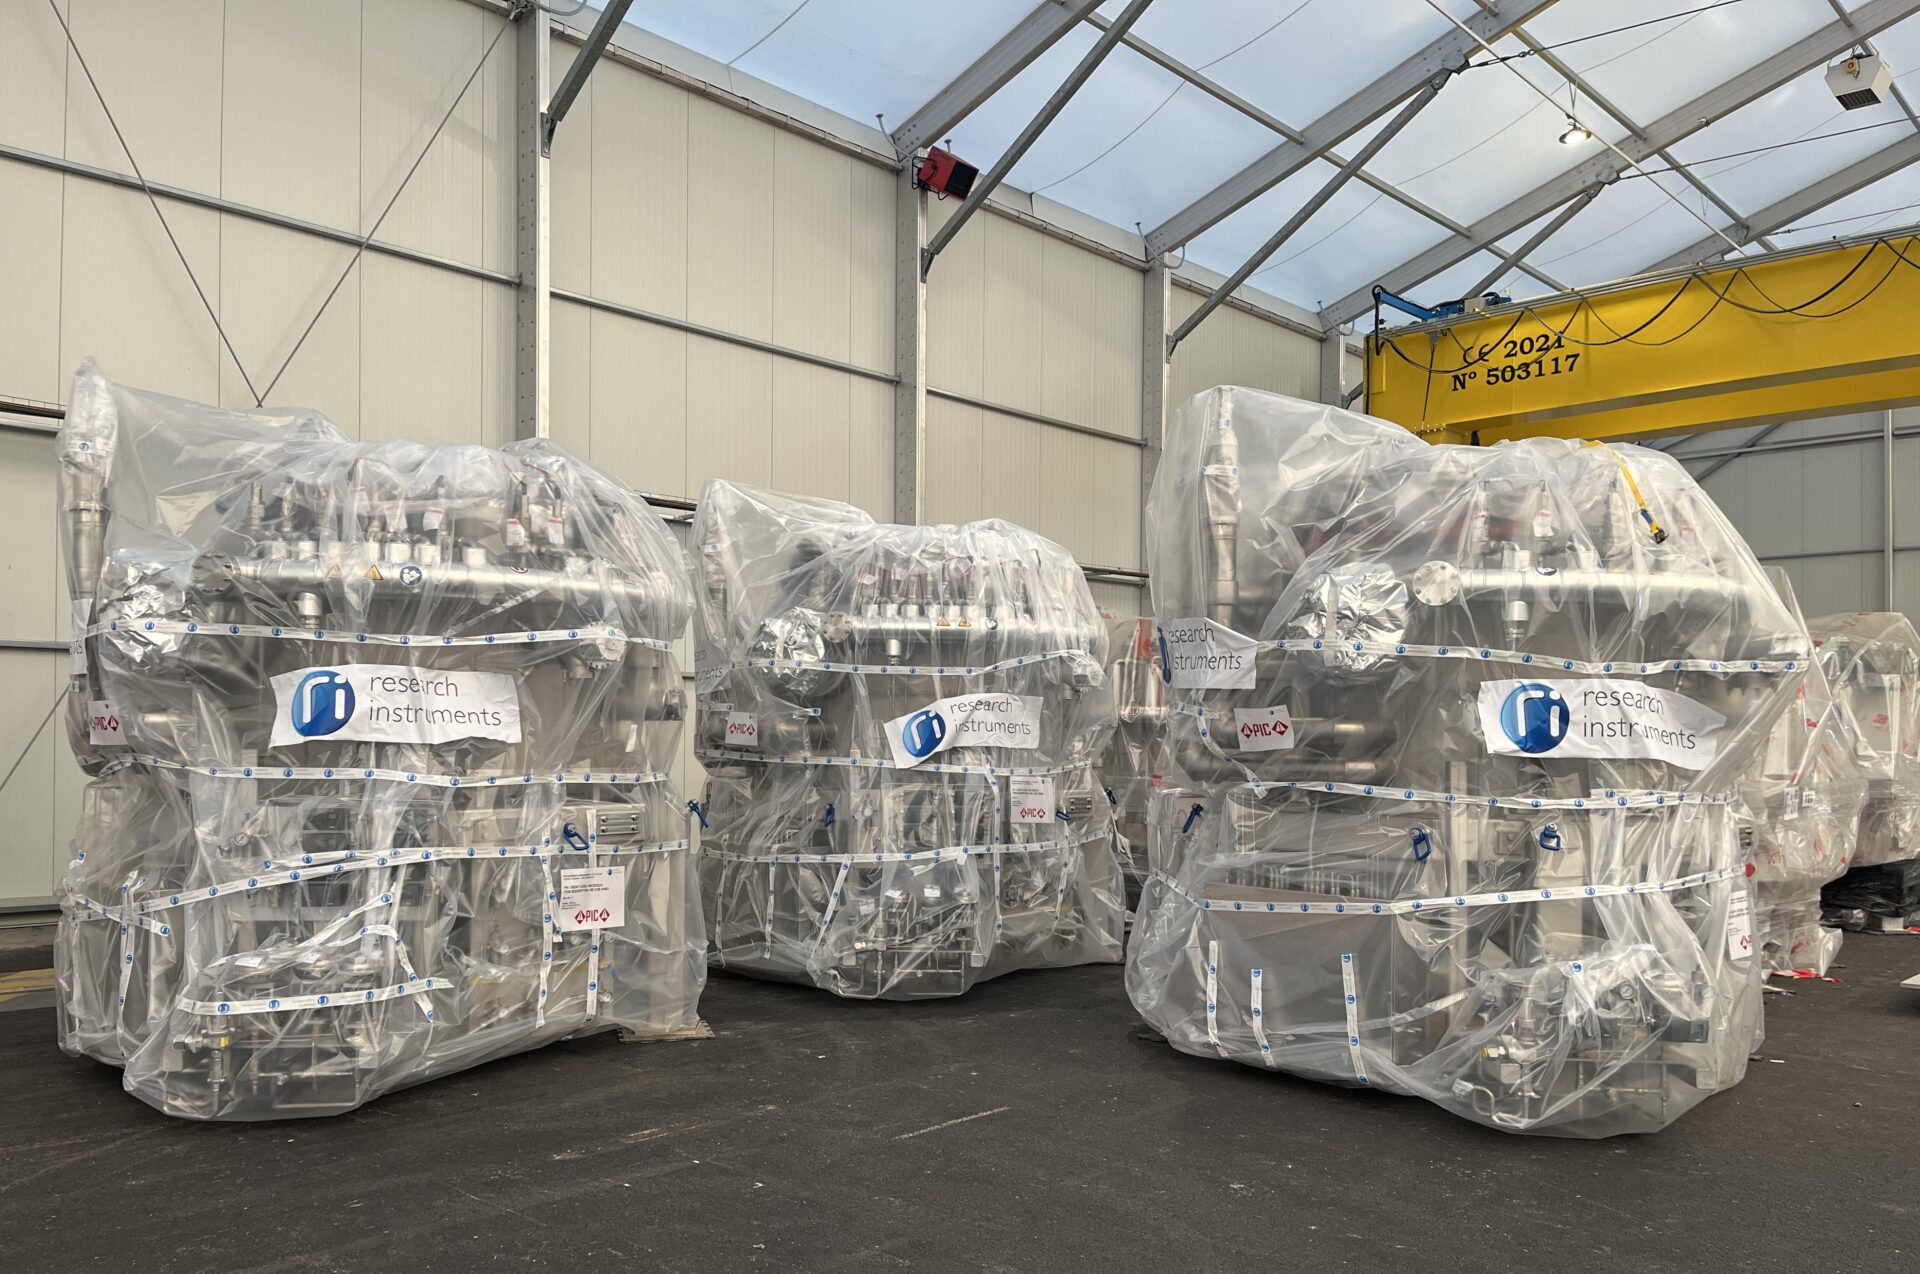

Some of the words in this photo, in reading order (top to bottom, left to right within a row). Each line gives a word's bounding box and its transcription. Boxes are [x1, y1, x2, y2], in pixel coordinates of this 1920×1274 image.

[1503, 331, 1566, 359] 2021
[1486, 353, 1580, 386] 503117
[1168, 622, 1215, 644] esearch
[950, 697, 1013, 714] research
[1583, 689, 1665, 715] research
[736, 723, 747, 734] PIC
[954, 719, 1031, 736] instruments
[1252, 723, 1272, 737] PIC
[1583, 715, 1697, 750] instruments
[1027, 808, 1037, 818] PIC
[585, 909, 599, 922] PIC
